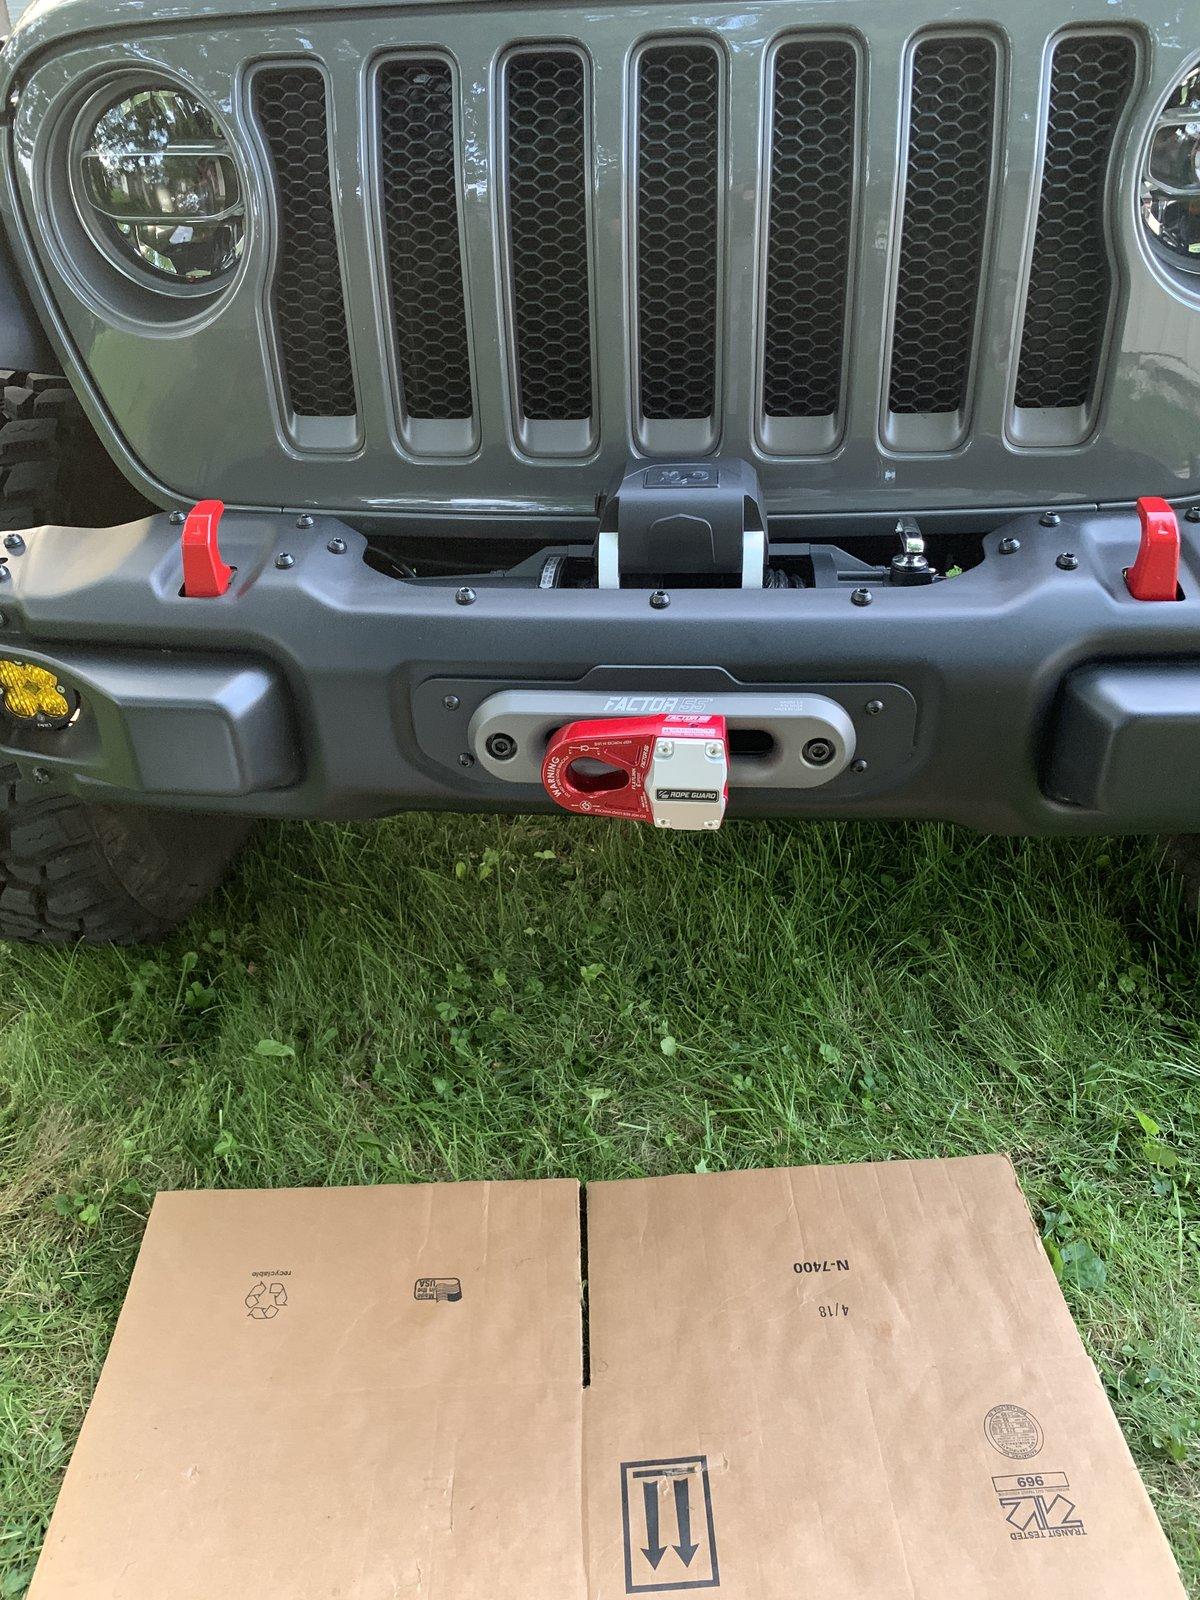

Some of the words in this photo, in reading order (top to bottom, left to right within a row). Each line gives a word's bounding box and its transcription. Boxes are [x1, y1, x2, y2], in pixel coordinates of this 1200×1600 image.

[603, 696, 679, 712] FACTOR
[679, 697, 709, 712] 55
[546, 756, 562, 798] WARNING
[670, 790, 690, 799] ROPE
[690, 791, 717, 800] GUARD
[793, 1259, 850, 1274] N-7400
[251, 1269, 292, 1277] recyclable
[418, 1280, 436, 1288] USA
[818, 1302, 849, 1318] 4/18
[1017, 1475, 1044, 1488] 969
[1009, 1530, 1046, 1541] TESTED
[1048, 1527, 1087, 1538] TRANSIT
